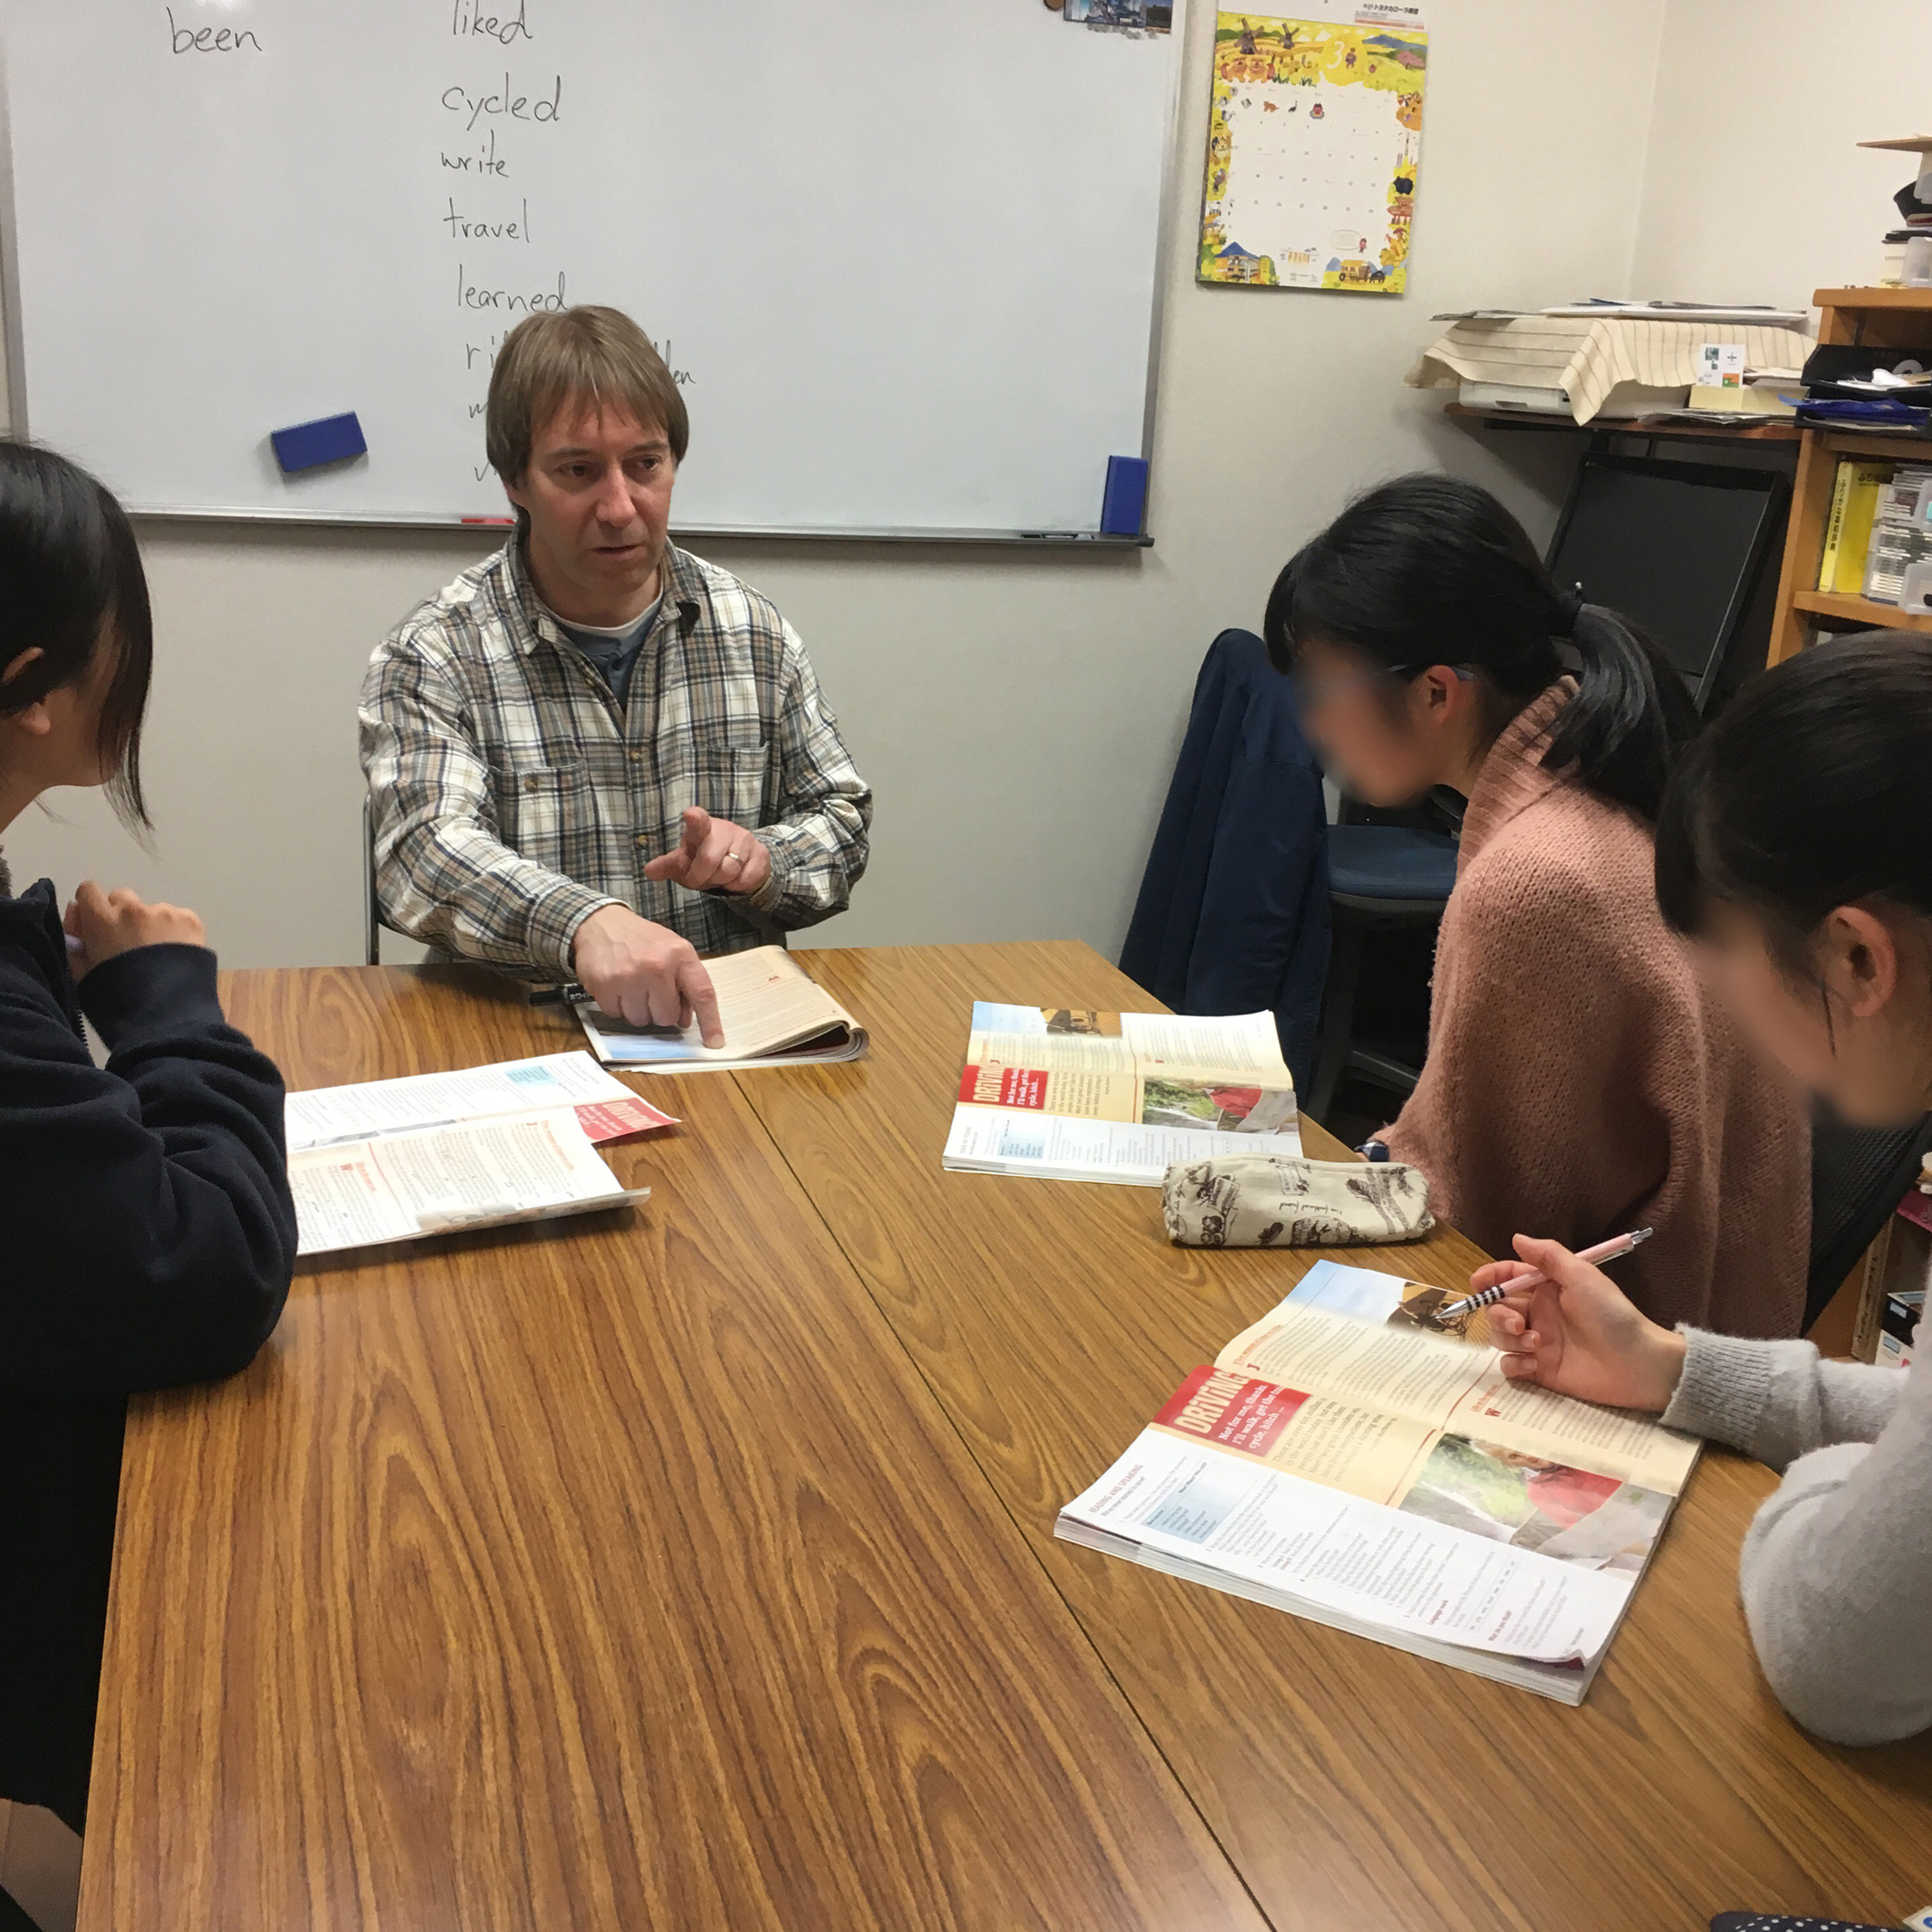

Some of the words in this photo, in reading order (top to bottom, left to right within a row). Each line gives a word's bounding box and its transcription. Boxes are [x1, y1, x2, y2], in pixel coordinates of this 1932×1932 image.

[168, 8, 263, 54] been
[452, 0, 534, 44] liked
[1325, 41, 1345, 70] 3
[441, 72, 562, 130] cycled
[441, 130, 510, 178] write
[443, 197, 530, 244] travel
[457, 264, 566, 313] learned
[1256, 1404, 1271, 1418] get
[1263, 1393, 1277, 1406] the
[1219, 1426, 1235, 1440] Not
[1228, 1416, 1243, 1428] for
[1237, 1404, 1254, 1418] me,
[1240, 1414, 1263, 1435] walk,
[1248, 1429, 1271, 1450] cycle,
[1261, 1411, 1282, 1430] hitch
[1233, 1432, 1248, 1445] I'll
[1273, 1446, 1291, 1463] There
[1297, 1433, 1313, 1450] world
[1108, 1485, 1124, 1496] AND
